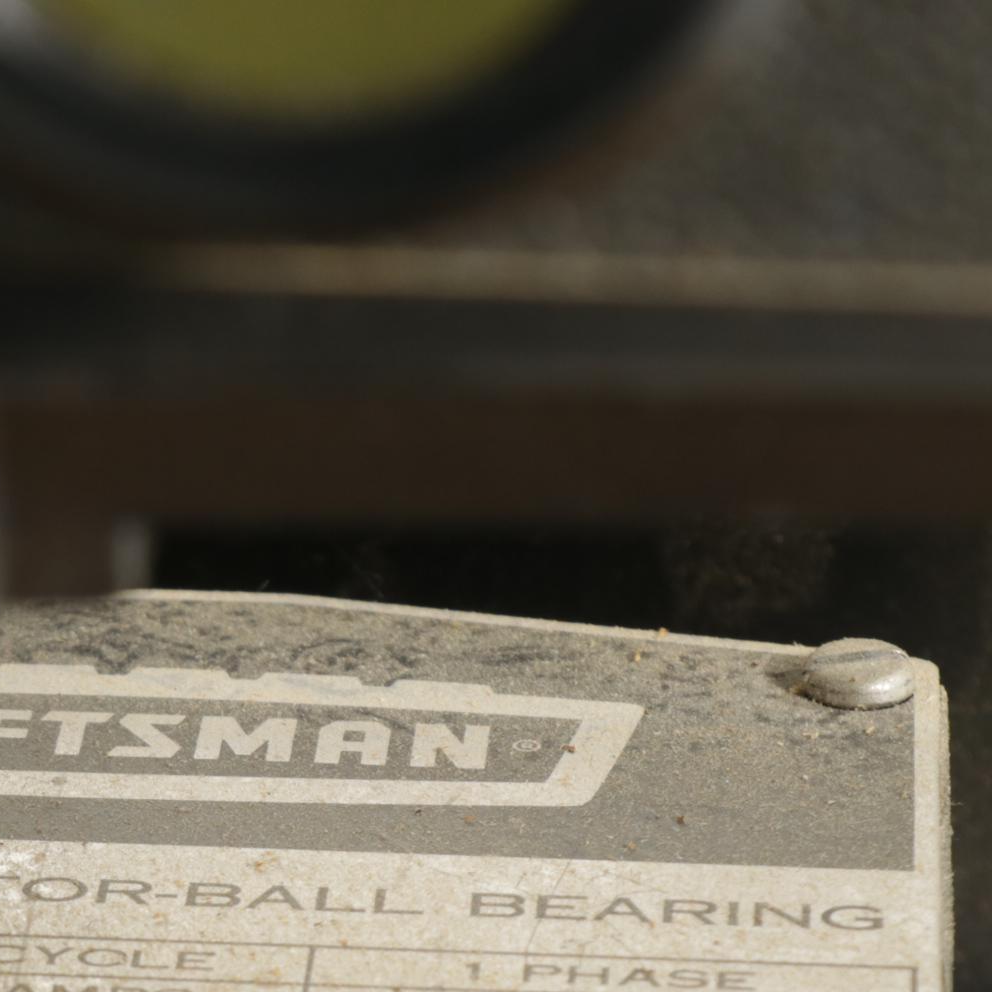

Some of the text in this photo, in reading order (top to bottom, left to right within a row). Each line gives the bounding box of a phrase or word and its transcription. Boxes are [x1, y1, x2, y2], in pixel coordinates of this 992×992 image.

[469, 890, 885, 932] BEARING
[465, 962, 756, 991] 1 PHASE
